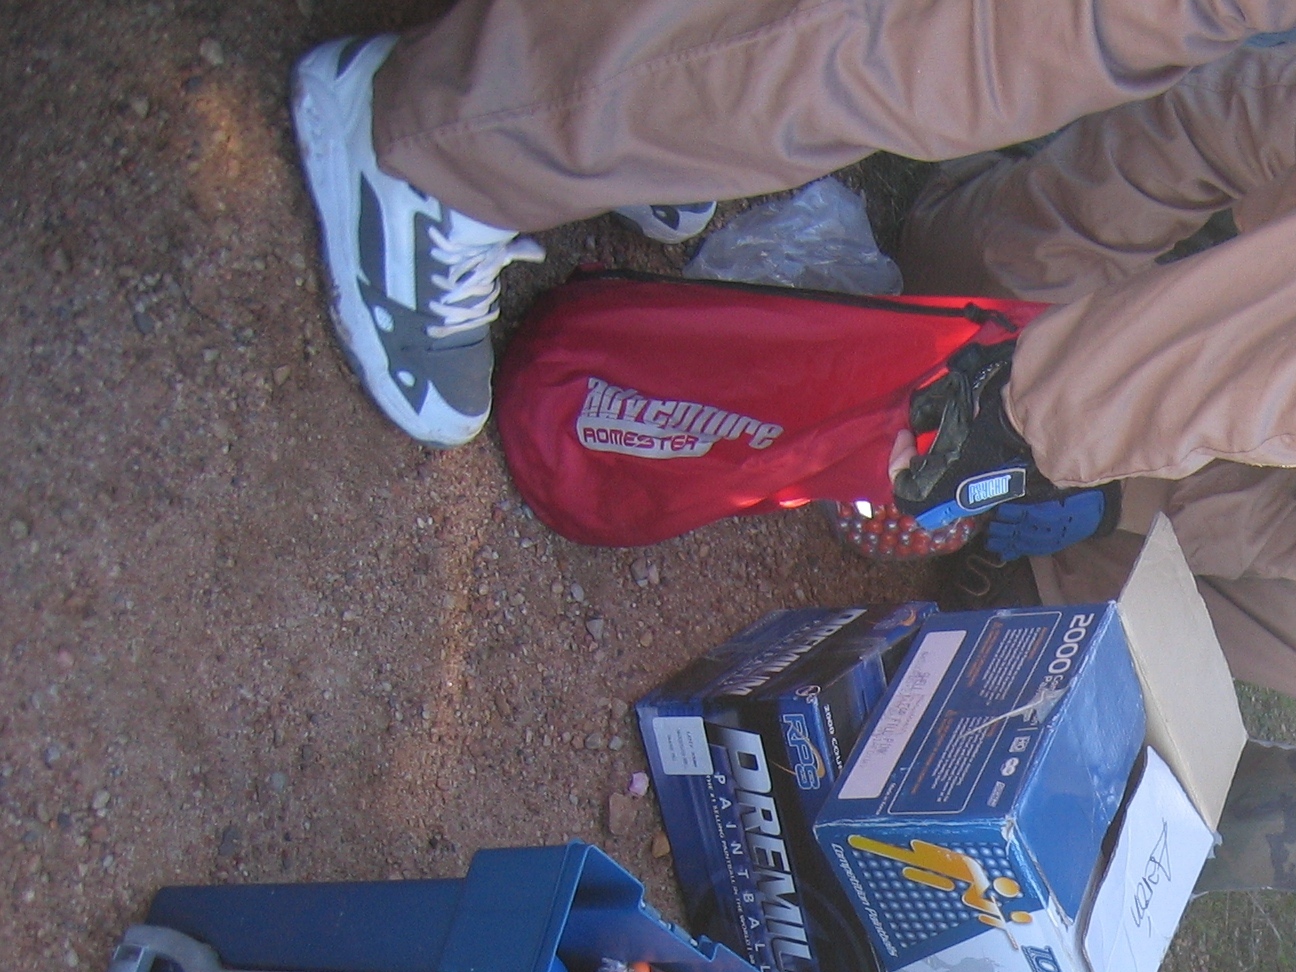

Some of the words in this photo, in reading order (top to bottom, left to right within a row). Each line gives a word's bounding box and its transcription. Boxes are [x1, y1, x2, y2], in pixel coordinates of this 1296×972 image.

[968, 475, 1012, 505] PSYCHO
[1048, 613, 1095, 674] 2000
[783, 713, 821, 791] RPS
[713, 805, 726, 839] SELLING
[721, 840, 736, 883] PAINTBALL
[831, 843, 870, 906] Competition
